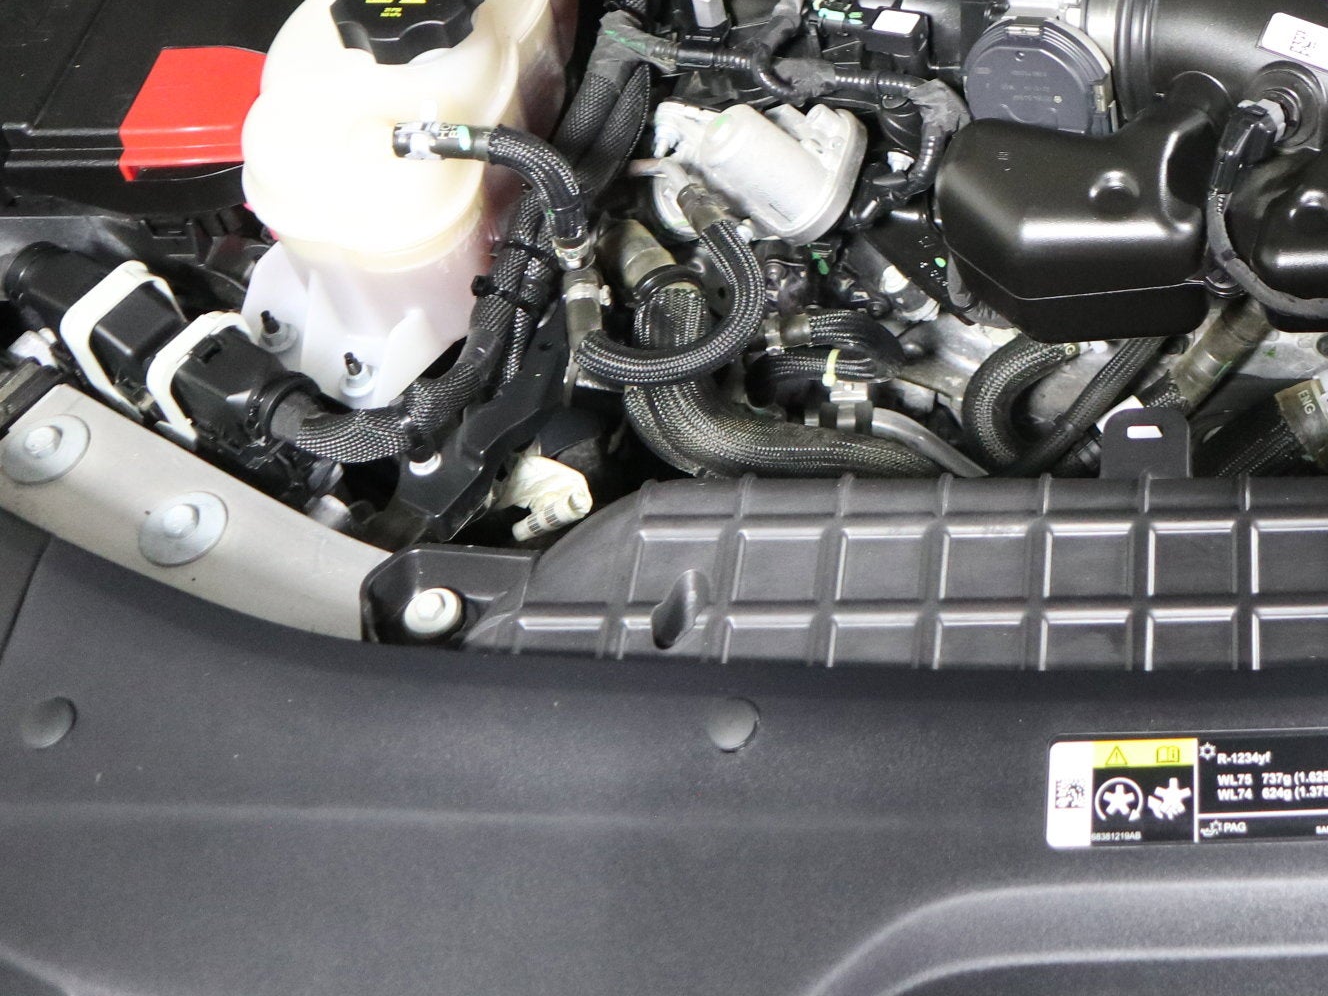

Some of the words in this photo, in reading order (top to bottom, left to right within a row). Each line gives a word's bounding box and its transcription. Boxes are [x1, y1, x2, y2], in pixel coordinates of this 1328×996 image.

[1297, 389, 1316, 415] ENG
[1216, 751, 1272, 766] R-1234yf
[1216, 773, 1253, 787] WL75
[1261, 772, 1292, 787] 737g
[1216, 787, 1253, 801] WL74
[1261, 786, 1293, 802] 624g
[1223, 822, 1247, 833] PAG
